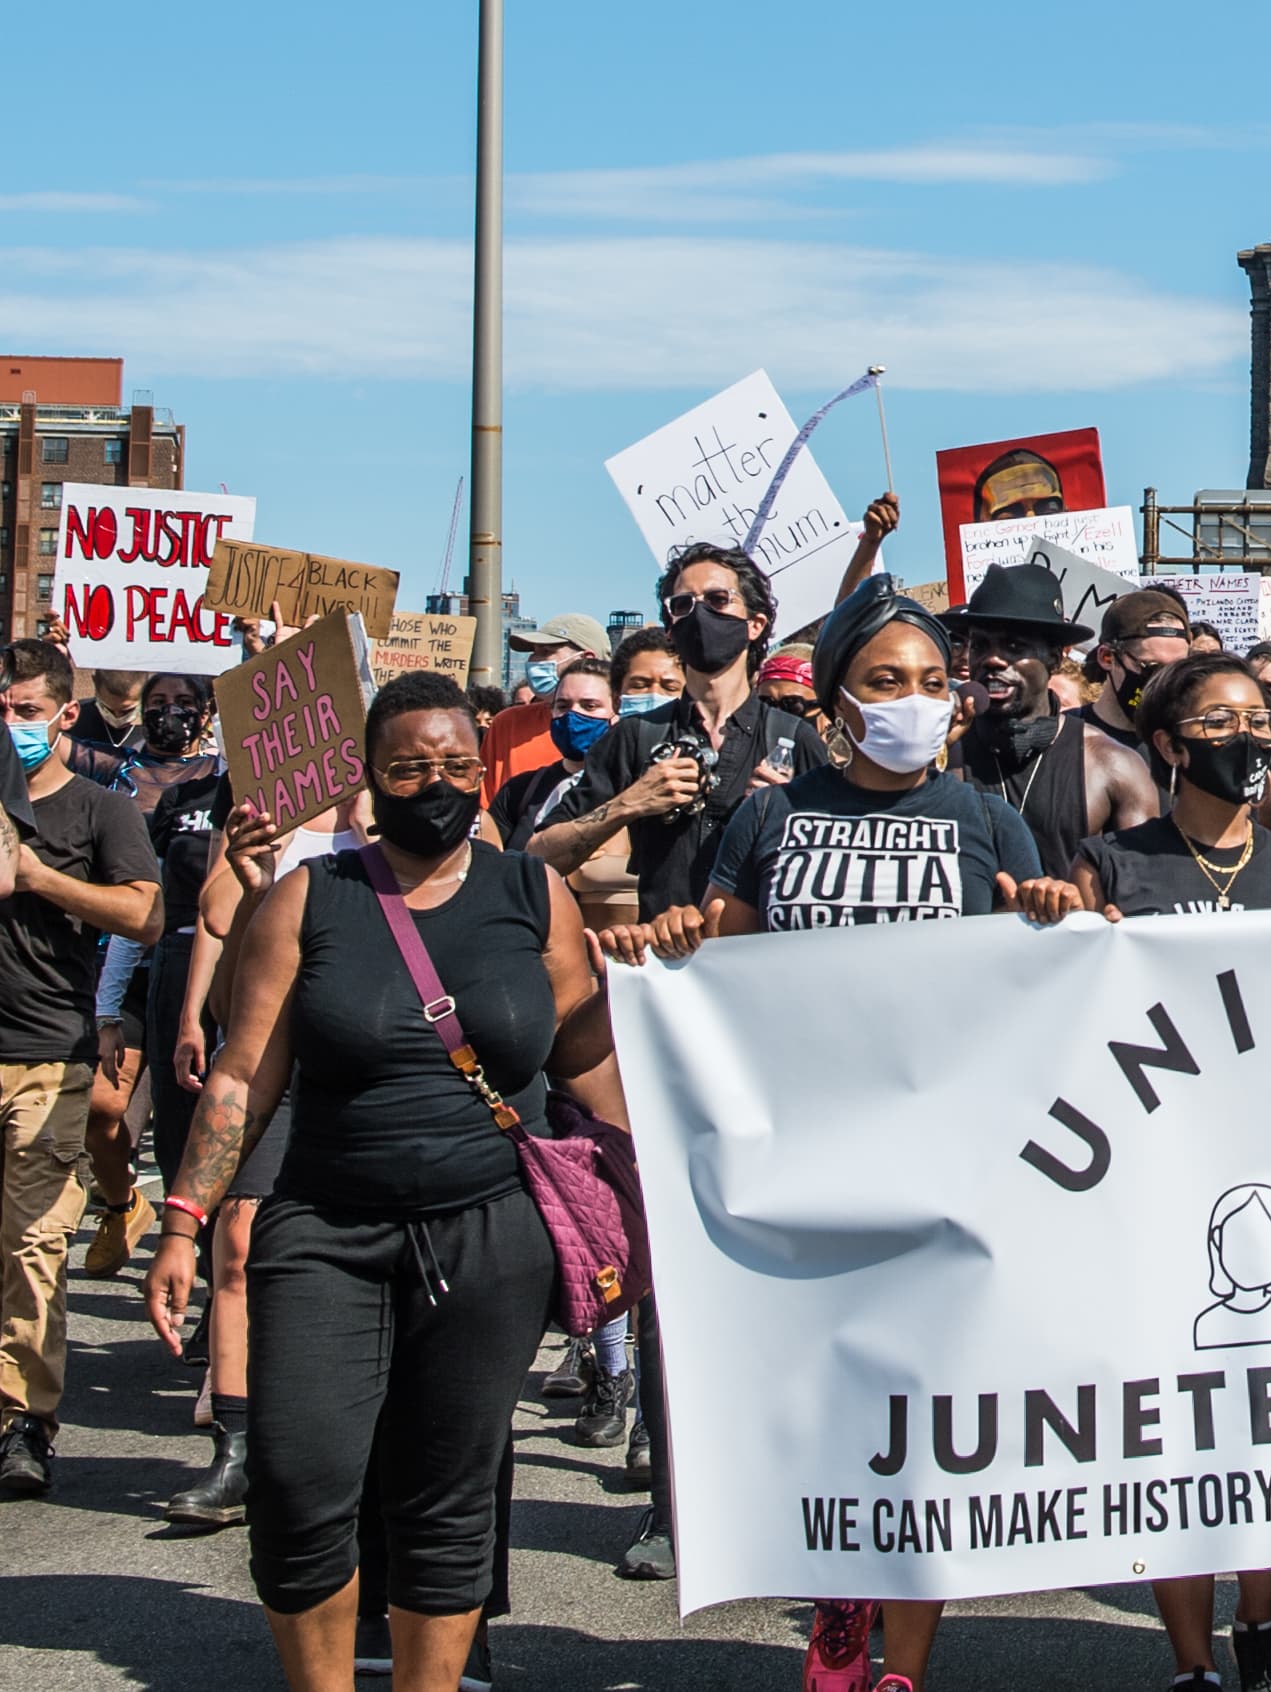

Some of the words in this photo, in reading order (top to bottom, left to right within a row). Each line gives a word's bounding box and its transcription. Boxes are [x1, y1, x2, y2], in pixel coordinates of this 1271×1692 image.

[65, 505, 117, 560] NO
[286, 566, 307, 622] 4
[308, 560, 379, 591] BLACK
[1210, 576, 1249, 590] NAMES
[64, 583, 115, 641] NO
[391, 619, 422, 633] HOSE
[429, 621, 457, 636] WHO
[375, 650, 429, 668] MURDERS
[434, 656, 467, 671] WRITE
[377, 638, 422, 649] COMMIT
[428, 640, 452, 652] THE
[252, 641, 316, 721] SAY
[241, 693, 342, 780] THEIR
[788, 818, 951, 850] STRAIGHT
[775, 851, 954, 903] OUTTA
[801, 1497, 860, 1551] WE
[872, 1497, 953, 1554] CAN
[968, 1486, 1088, 1550] MAKE
